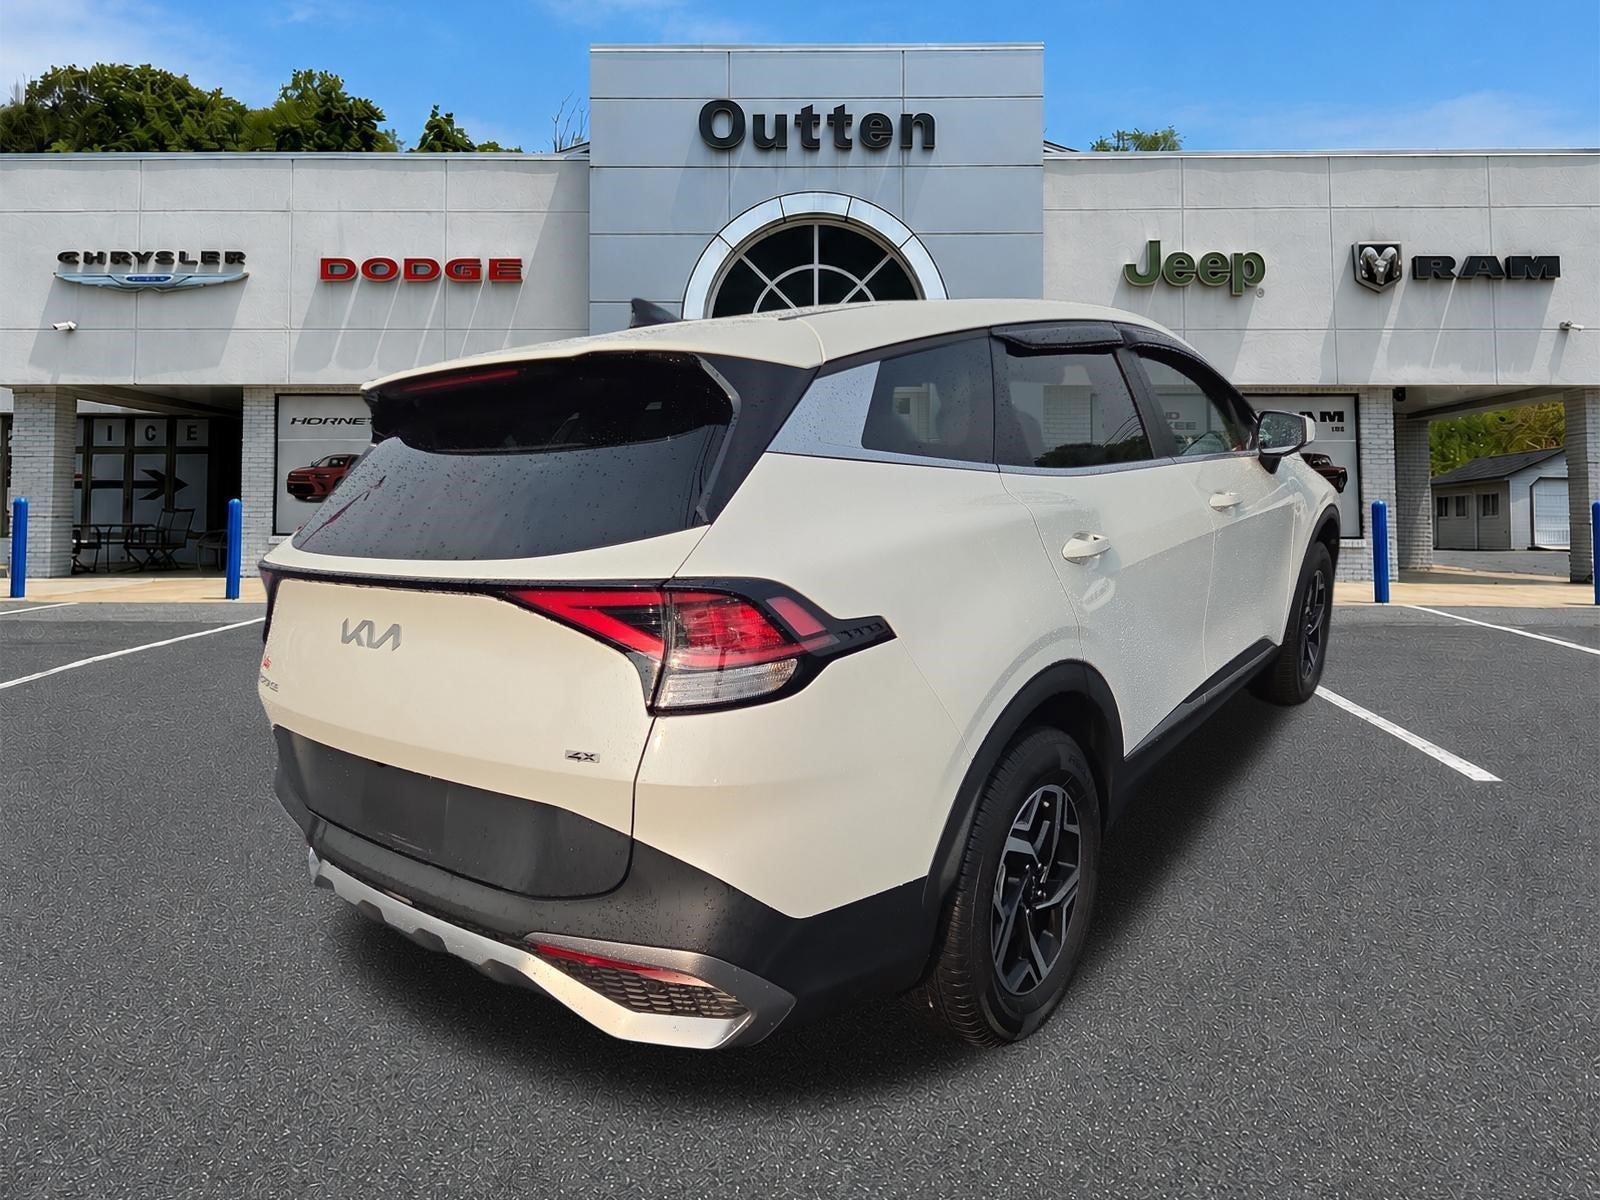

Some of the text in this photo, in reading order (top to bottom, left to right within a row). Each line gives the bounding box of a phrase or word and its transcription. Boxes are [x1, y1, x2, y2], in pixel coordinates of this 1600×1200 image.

[698, 99, 936, 150] Outten
[57, 250, 247, 266] CHRYSLER
[320, 257, 523, 282] DODGE
[1123, 240, 1266, 296] Jeep
[1411, 255, 1561, 280] RAM
[341, 617, 401, 652] KIA
